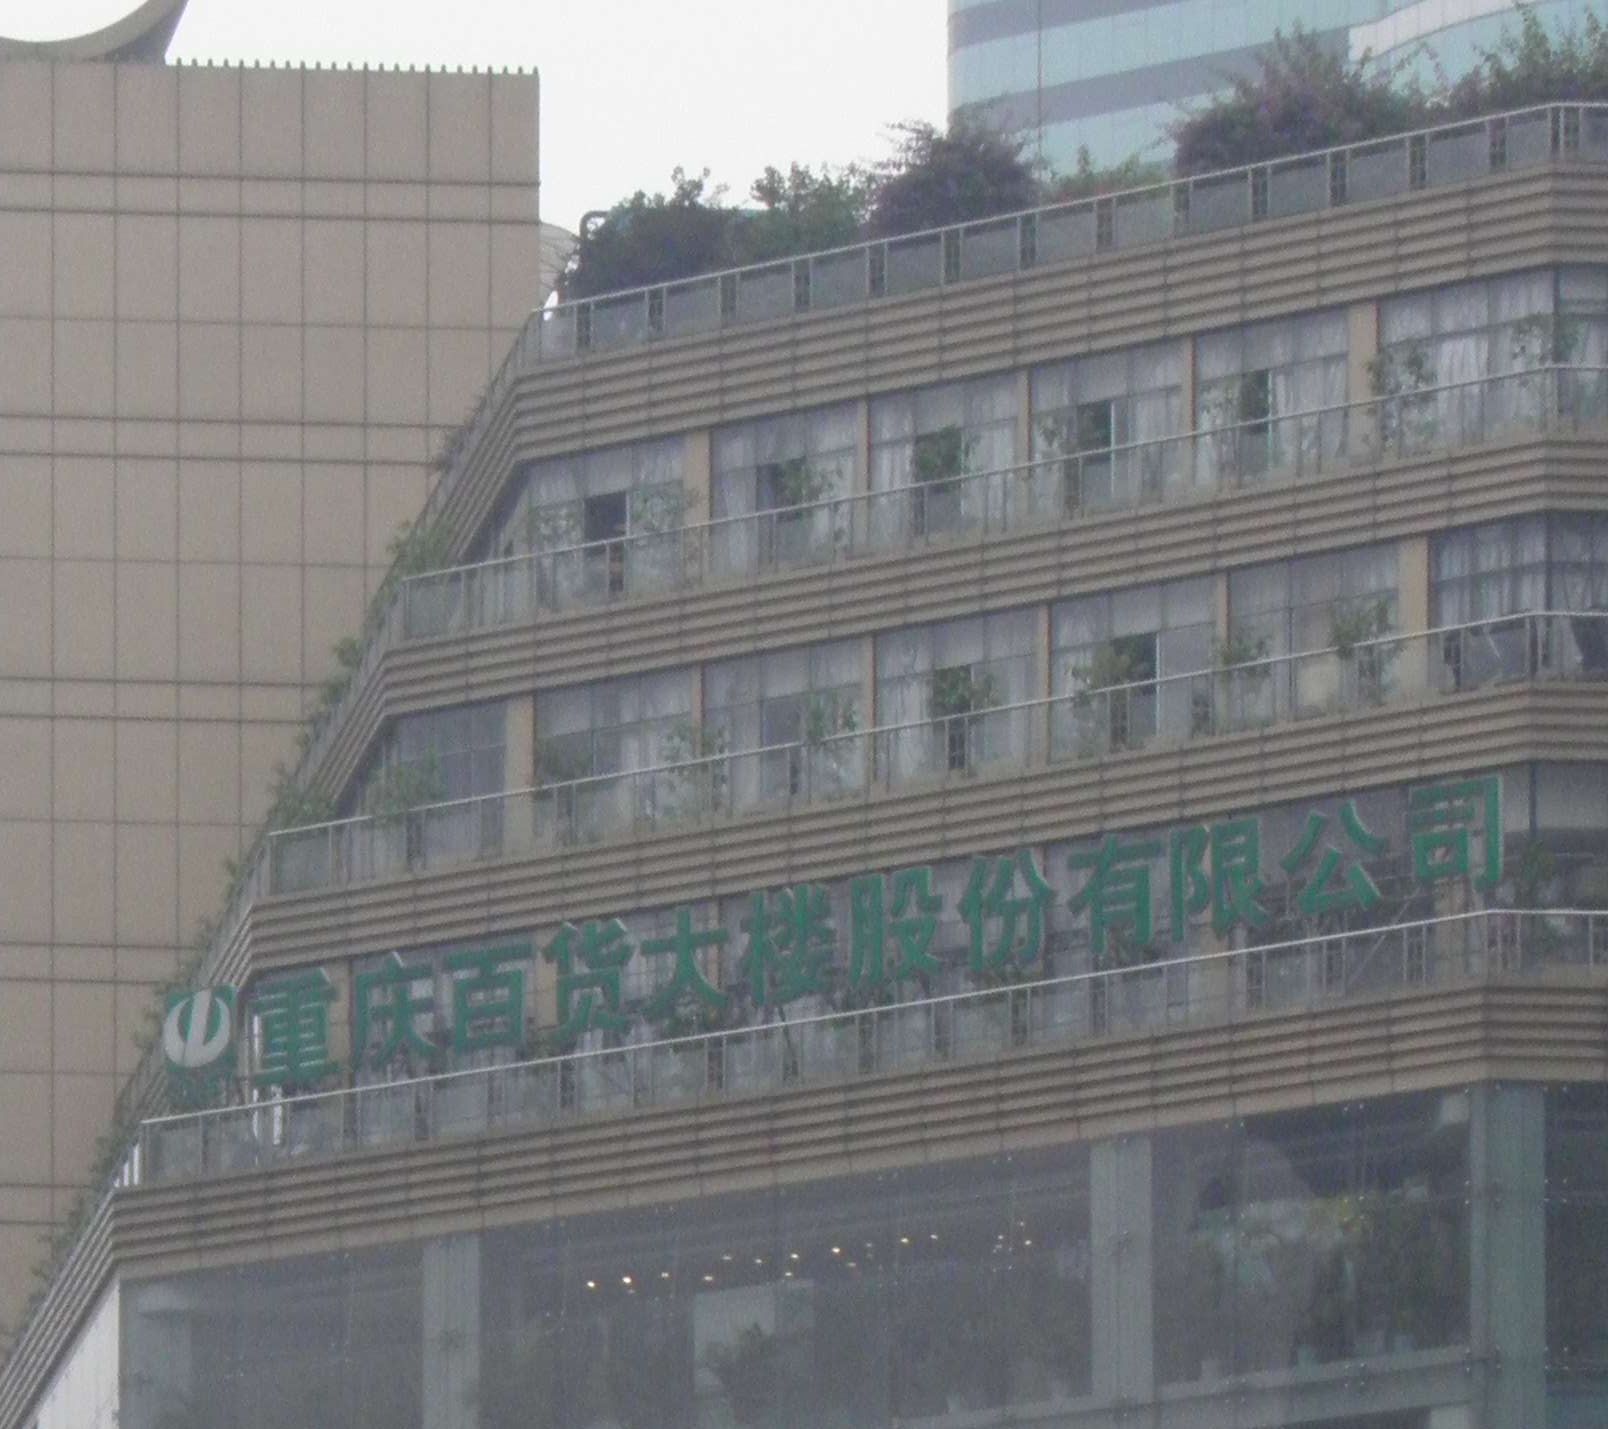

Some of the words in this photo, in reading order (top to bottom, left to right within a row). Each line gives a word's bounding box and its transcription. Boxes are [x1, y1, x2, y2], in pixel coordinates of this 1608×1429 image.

[254, 774, 1505, 1086] 重庆百货大楼股份有限公司
